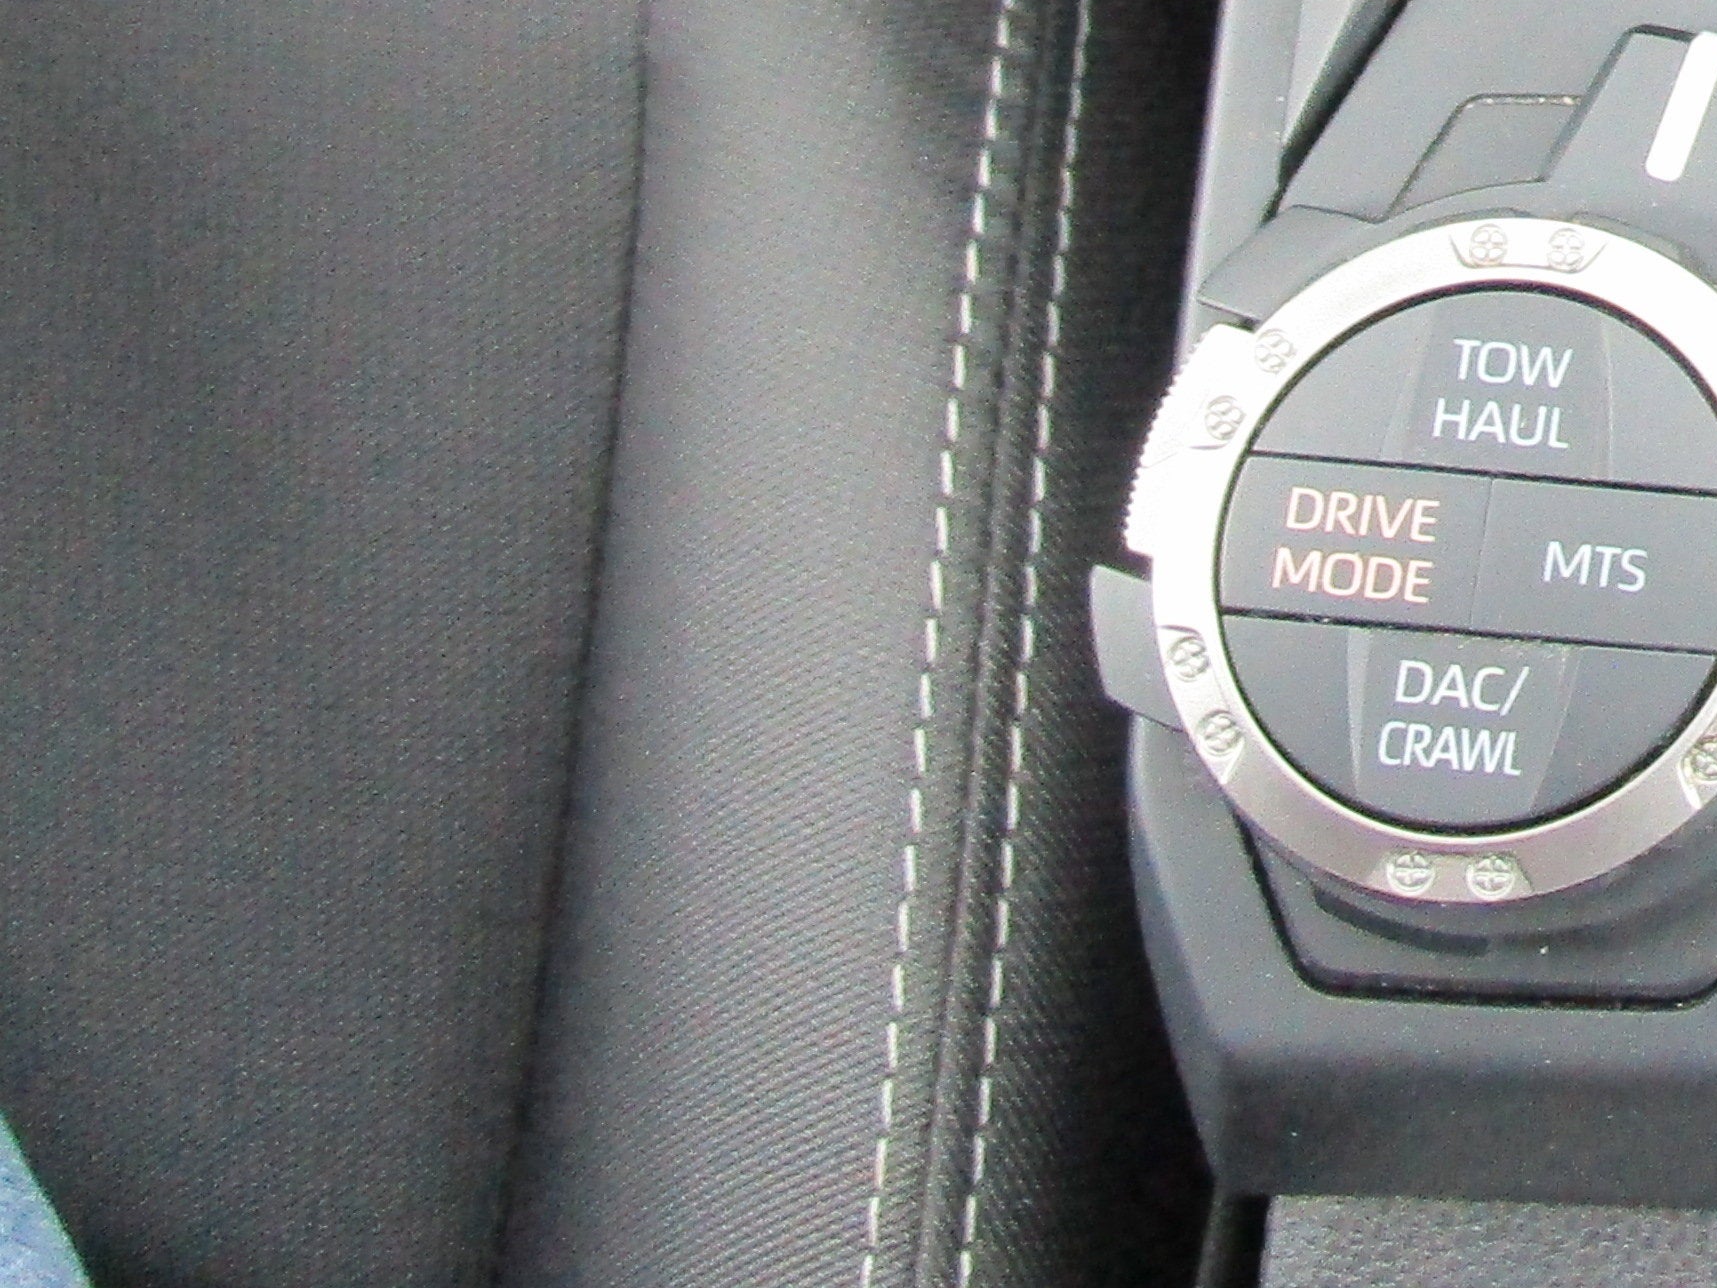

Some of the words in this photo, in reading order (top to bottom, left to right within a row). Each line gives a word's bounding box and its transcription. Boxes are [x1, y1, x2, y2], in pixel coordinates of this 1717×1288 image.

[1454, 338, 1573, 389] TOW
[1431, 397, 1571, 450] HAUL
[1285, 486, 1441, 544] DRIVE
[1270, 546, 1433, 604] MODE
[1542, 540, 1649, 594] MTS
[1394, 658, 1531, 716] DAC/
[1377, 720, 1523, 778] CRAWL
